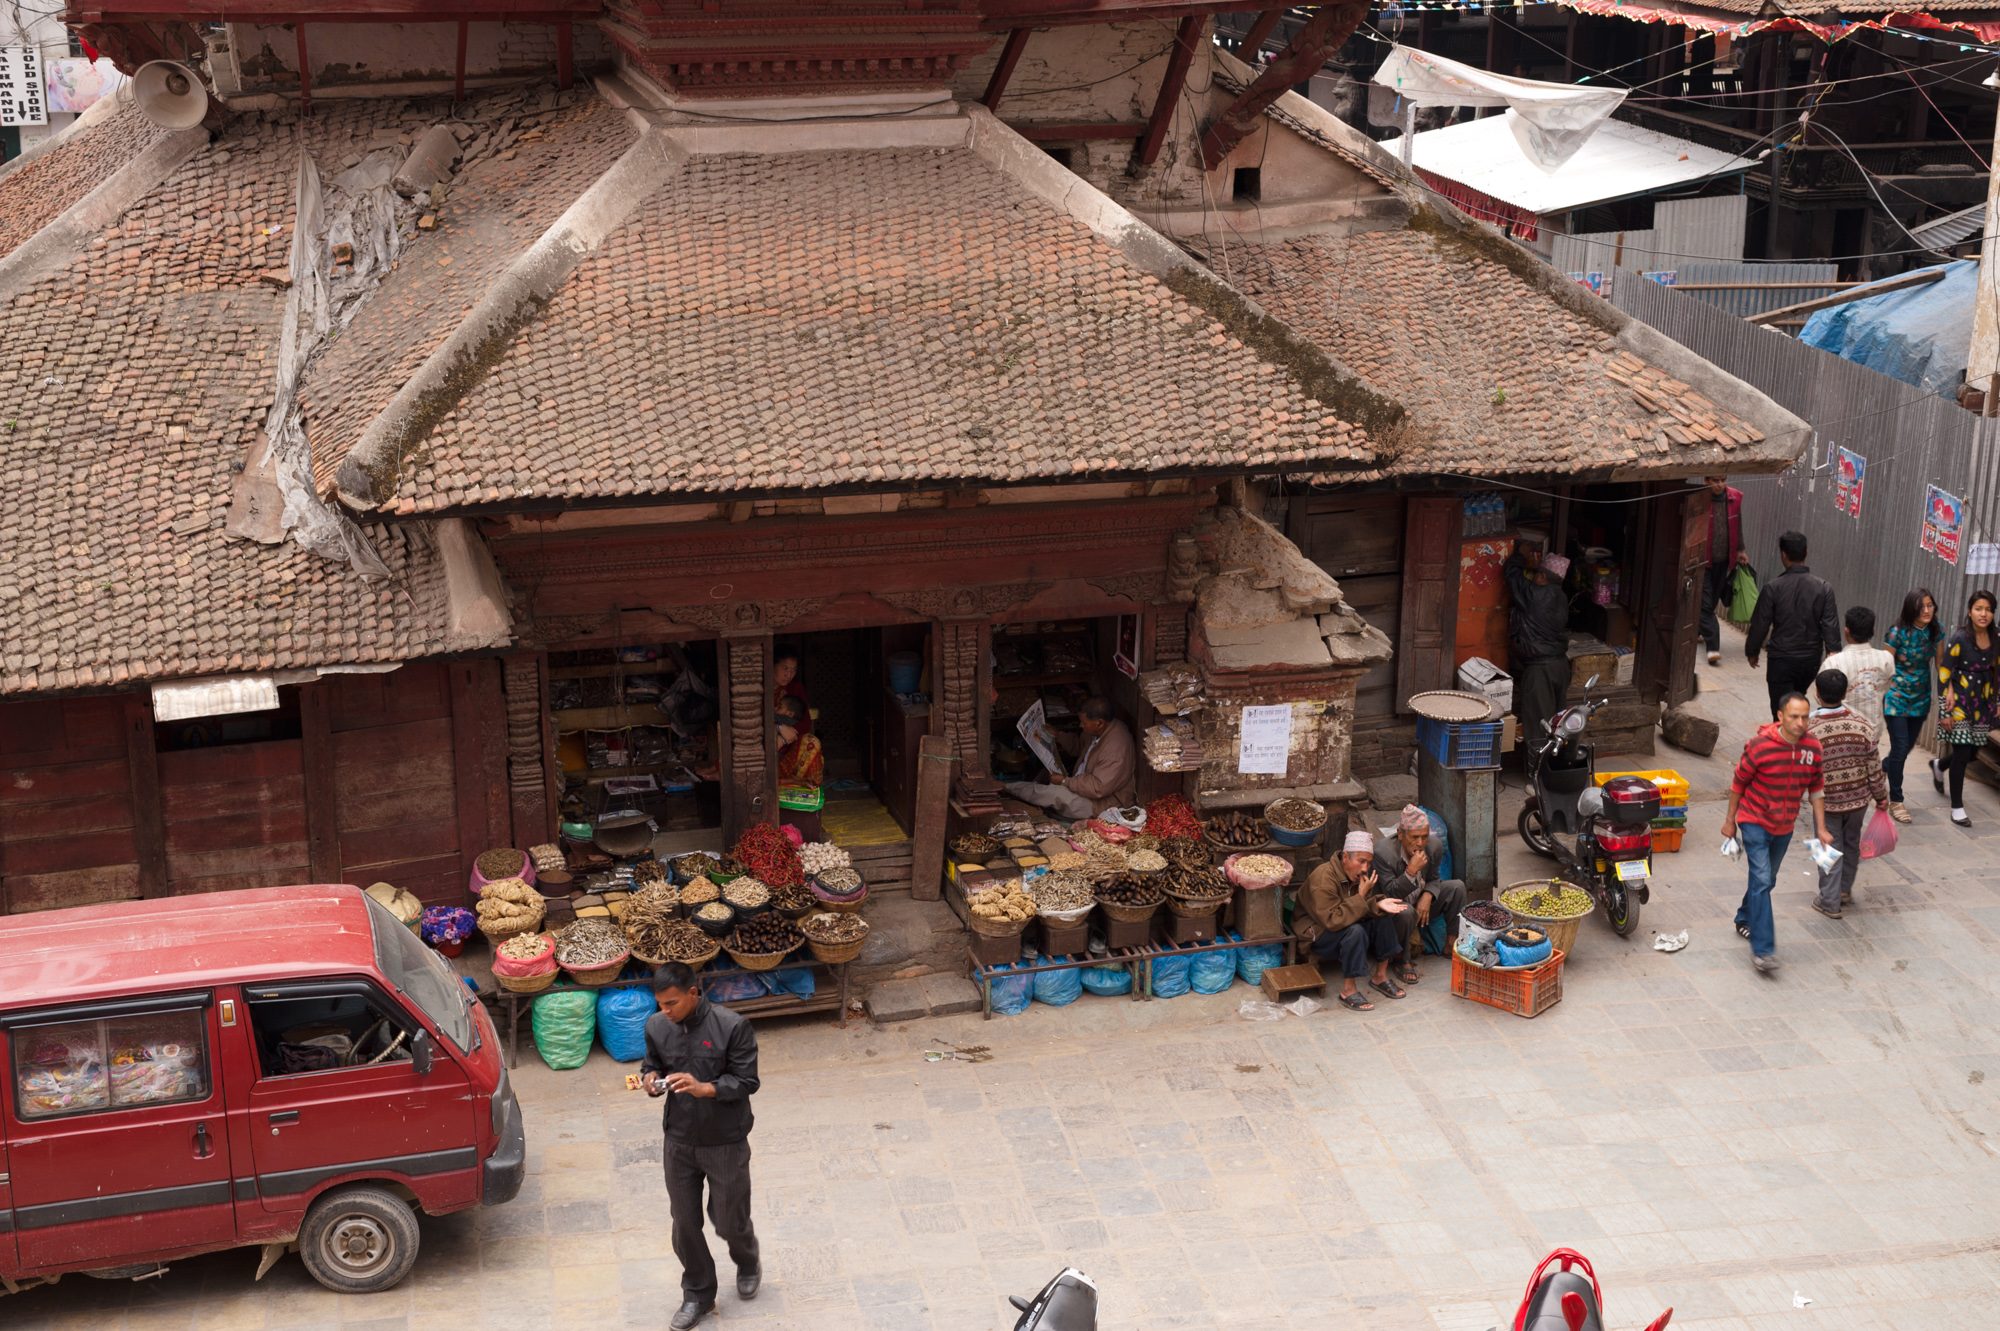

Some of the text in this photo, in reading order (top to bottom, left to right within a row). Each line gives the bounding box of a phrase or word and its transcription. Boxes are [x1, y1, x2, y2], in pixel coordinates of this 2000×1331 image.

[0, 47, 15, 122] KATHMANDU
[22, 47, 41, 120] COLD STORE
